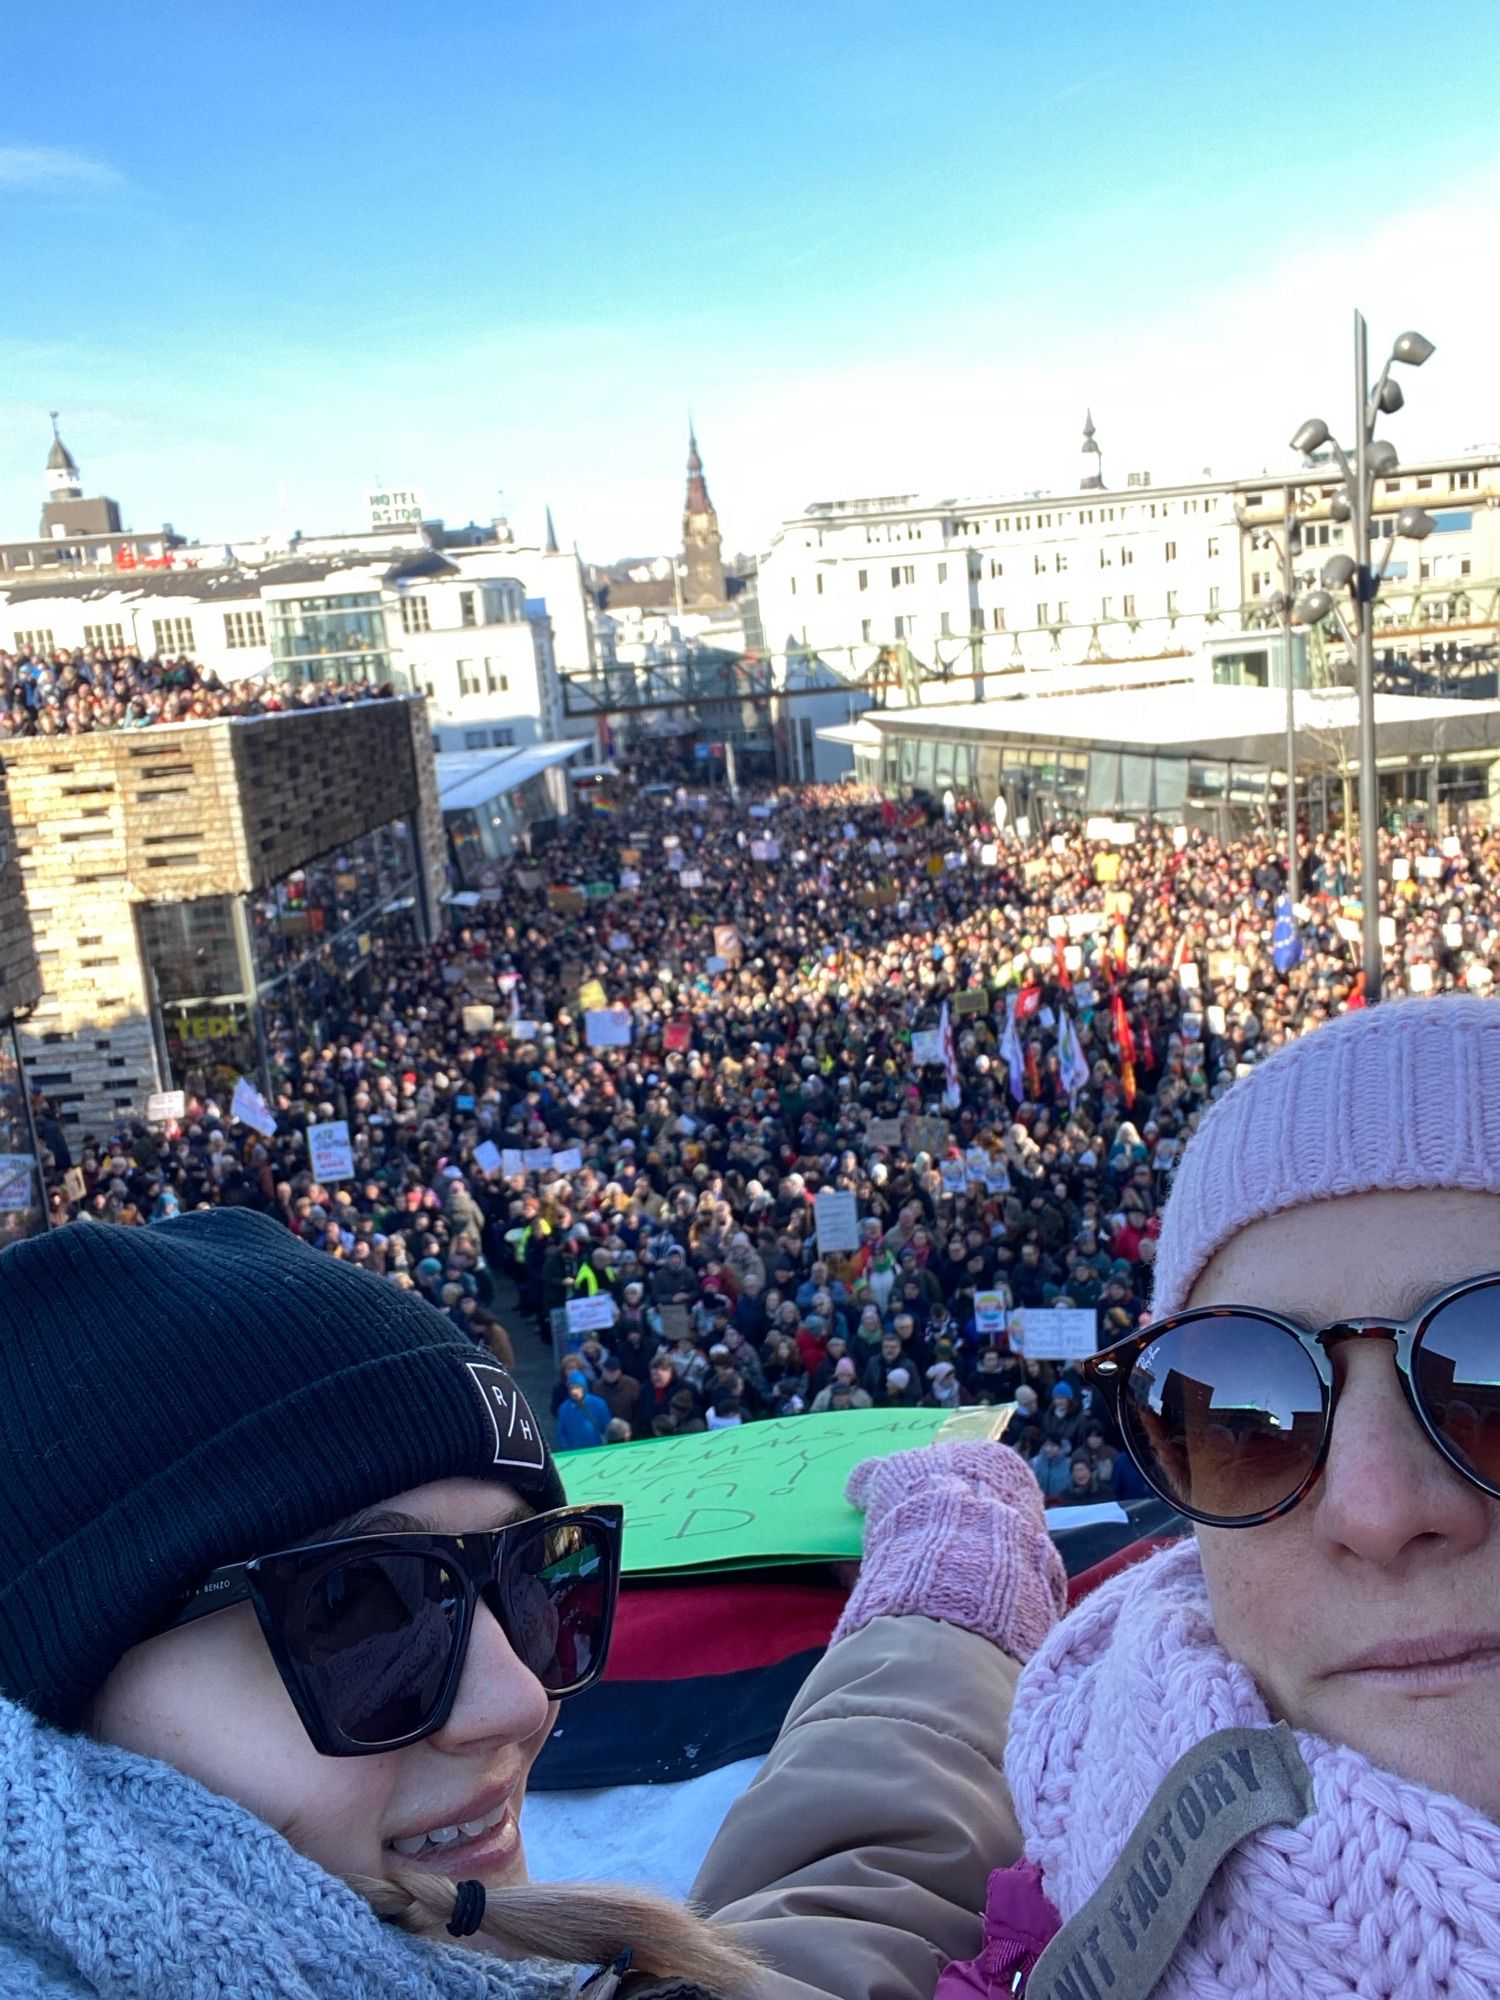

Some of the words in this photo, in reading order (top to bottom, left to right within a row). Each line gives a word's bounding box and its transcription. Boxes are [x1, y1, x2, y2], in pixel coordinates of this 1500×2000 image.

[204, 1579, 231, 1593] BENZO
[1047, 1926, 1116, 2000] NIT
[1110, 1748, 1262, 1952] FACTORY
